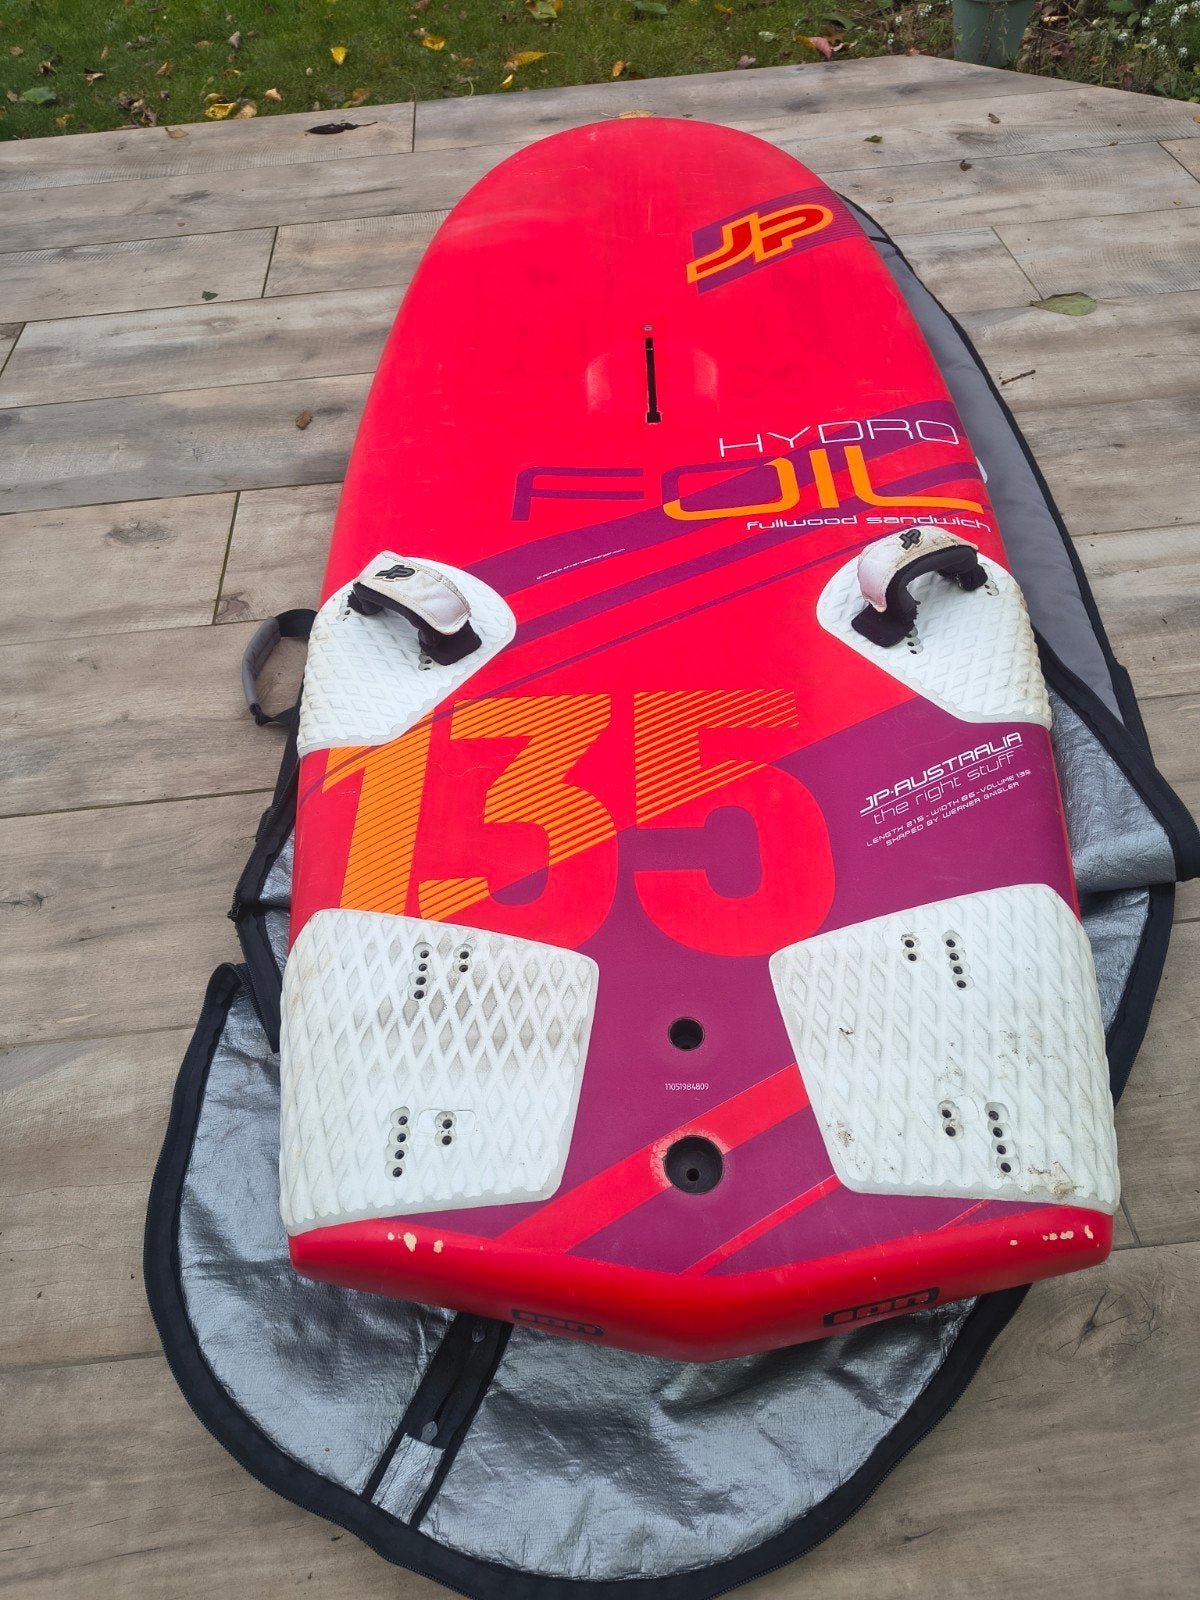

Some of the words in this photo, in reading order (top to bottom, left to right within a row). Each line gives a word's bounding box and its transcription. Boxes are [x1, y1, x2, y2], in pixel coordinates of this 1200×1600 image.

[686, 203, 834, 284] JP
[719, 418, 959, 458] HYDRO
[511, 445, 985, 522] FOIL
[746, 515, 858, 531] fullwood
[866, 514, 992, 533] sandwich
[321, 688, 836, 957] 135
[866, 825, 904, 847] LENGTH
[930, 798, 960, 816] WIDTH
[980, 775, 1015, 793] VOLUME
[873, 801, 910, 825] the
[915, 776, 962, 806] right
[967, 750, 1015, 781] stuff
[885, 824, 924, 847] SHAPED
[926, 816, 939, 827] BY
[942, 797, 981, 819] WERNER
